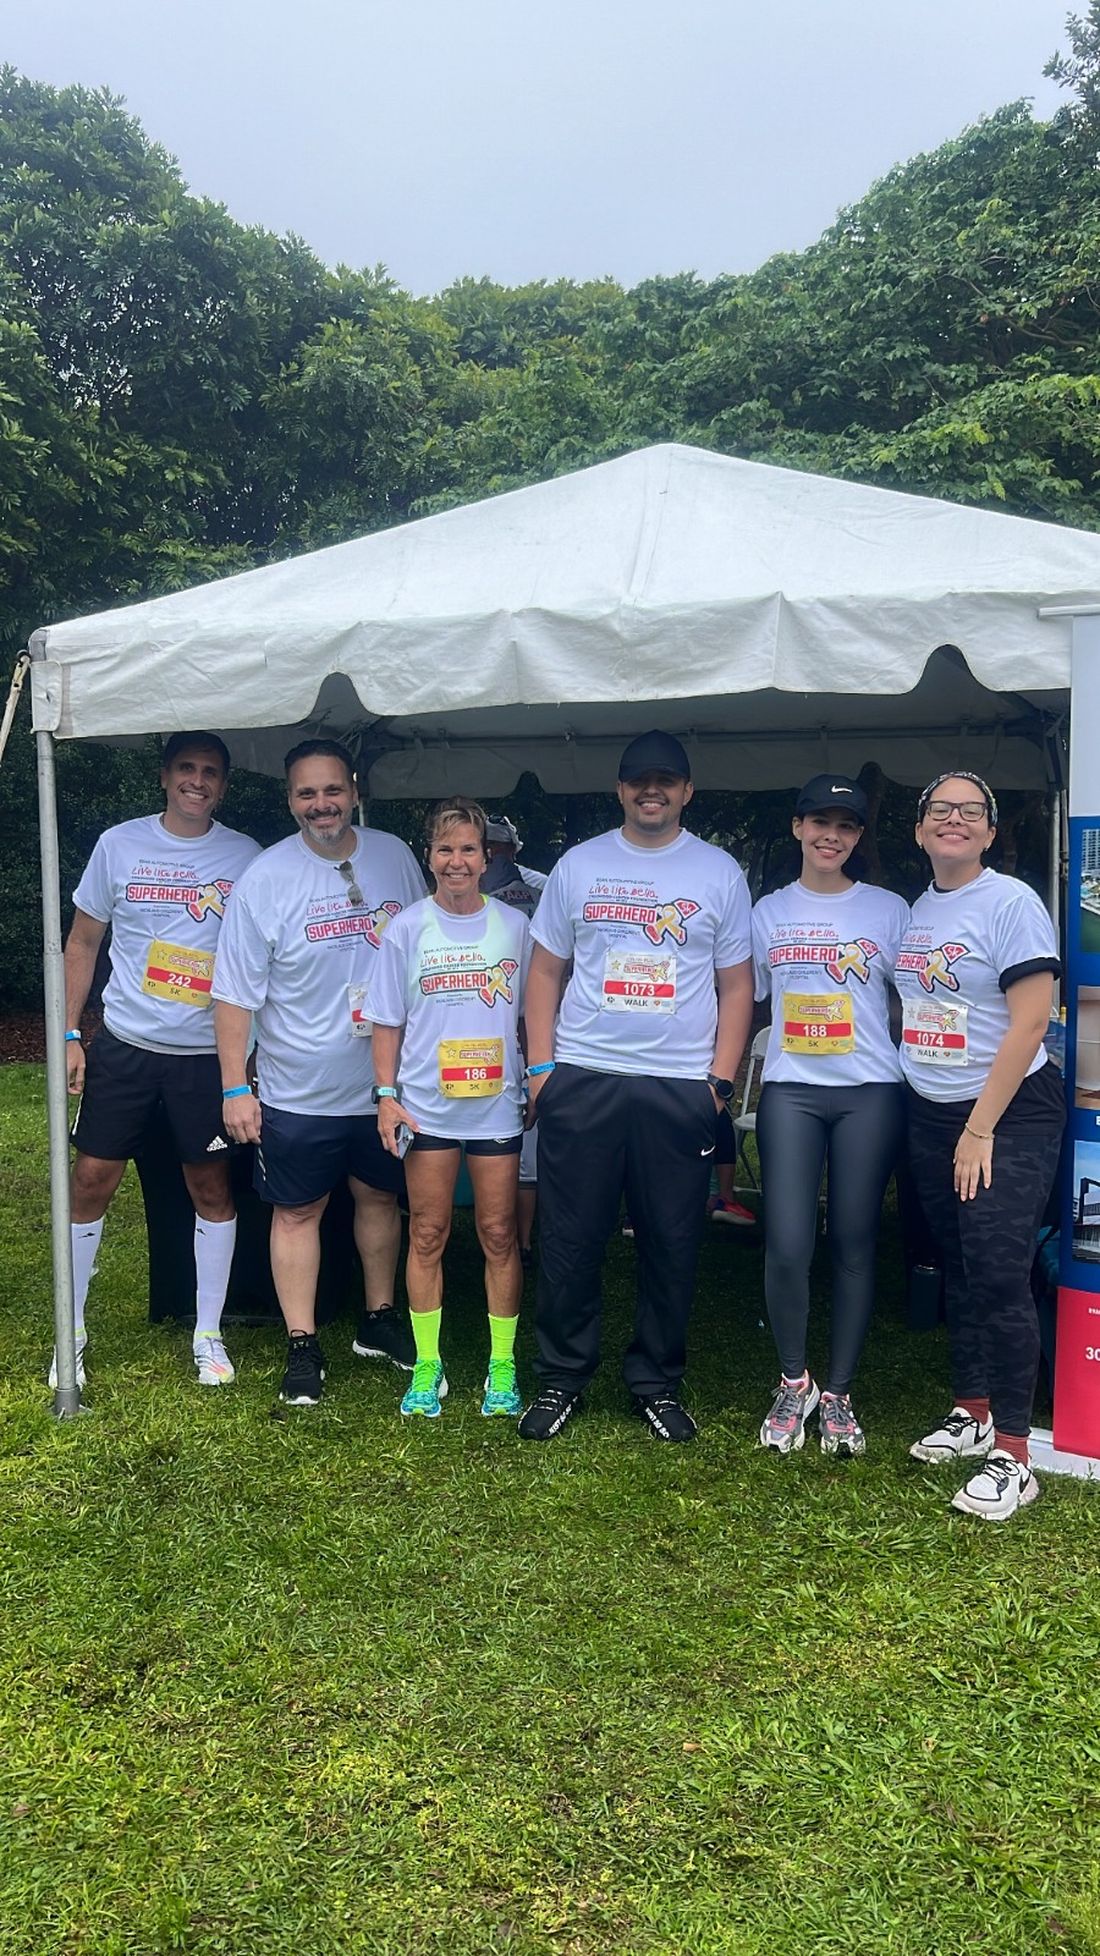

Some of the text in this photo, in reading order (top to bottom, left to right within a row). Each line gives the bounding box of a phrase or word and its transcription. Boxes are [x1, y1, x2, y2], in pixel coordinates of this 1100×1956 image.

[128, 886, 198, 903] SUPERHERO
[584, 904, 656, 924] SUPERHERO
[308, 917, 372, 939] SUPERHERO
[769, 946, 837, 966] SUPERHERO
[167, 972, 192, 988] 242
[422, 972, 487, 993] SUPERHERO
[623, 983, 655, 996] 1073
[624, 999, 649, 1007] WALK
[803, 1024, 827, 1037] 188
[808, 1040, 819, 1048] 5K
[917, 1032, 944, 1047] 1074
[917, 1049, 939, 1058] WALK
[464, 1068, 487, 1080] 186
